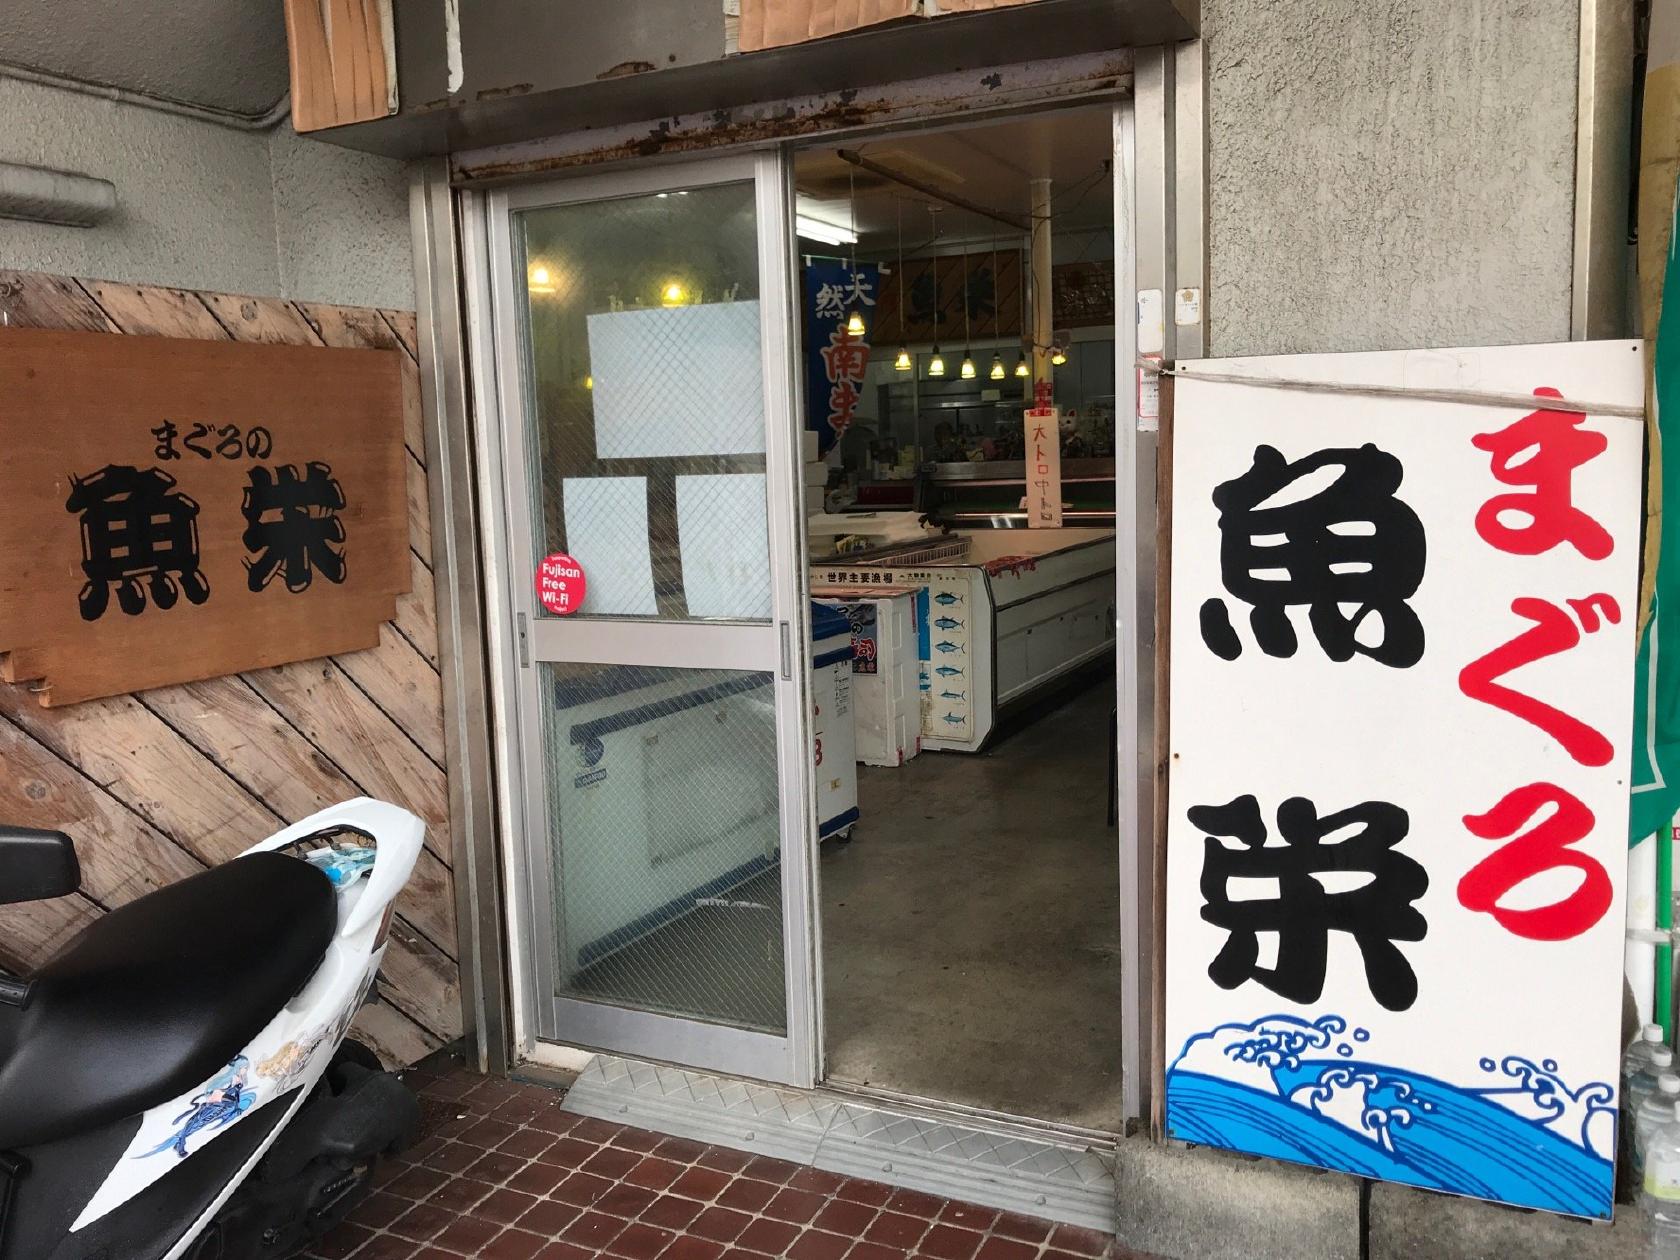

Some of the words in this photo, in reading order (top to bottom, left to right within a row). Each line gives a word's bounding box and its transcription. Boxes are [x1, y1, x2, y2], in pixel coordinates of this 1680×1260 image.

[151, 420, 273, 460] まぐろの
[66, 462, 346, 621] 魚栄
[542, 562, 580, 578] Fujisan
[542, 577, 566, 590] Free
[542, 591, 569, 606] Wi-Fi
[1457, 387, 1621, 941] まぐろ
[1188, 443, 1429, 1012] 魚栄
